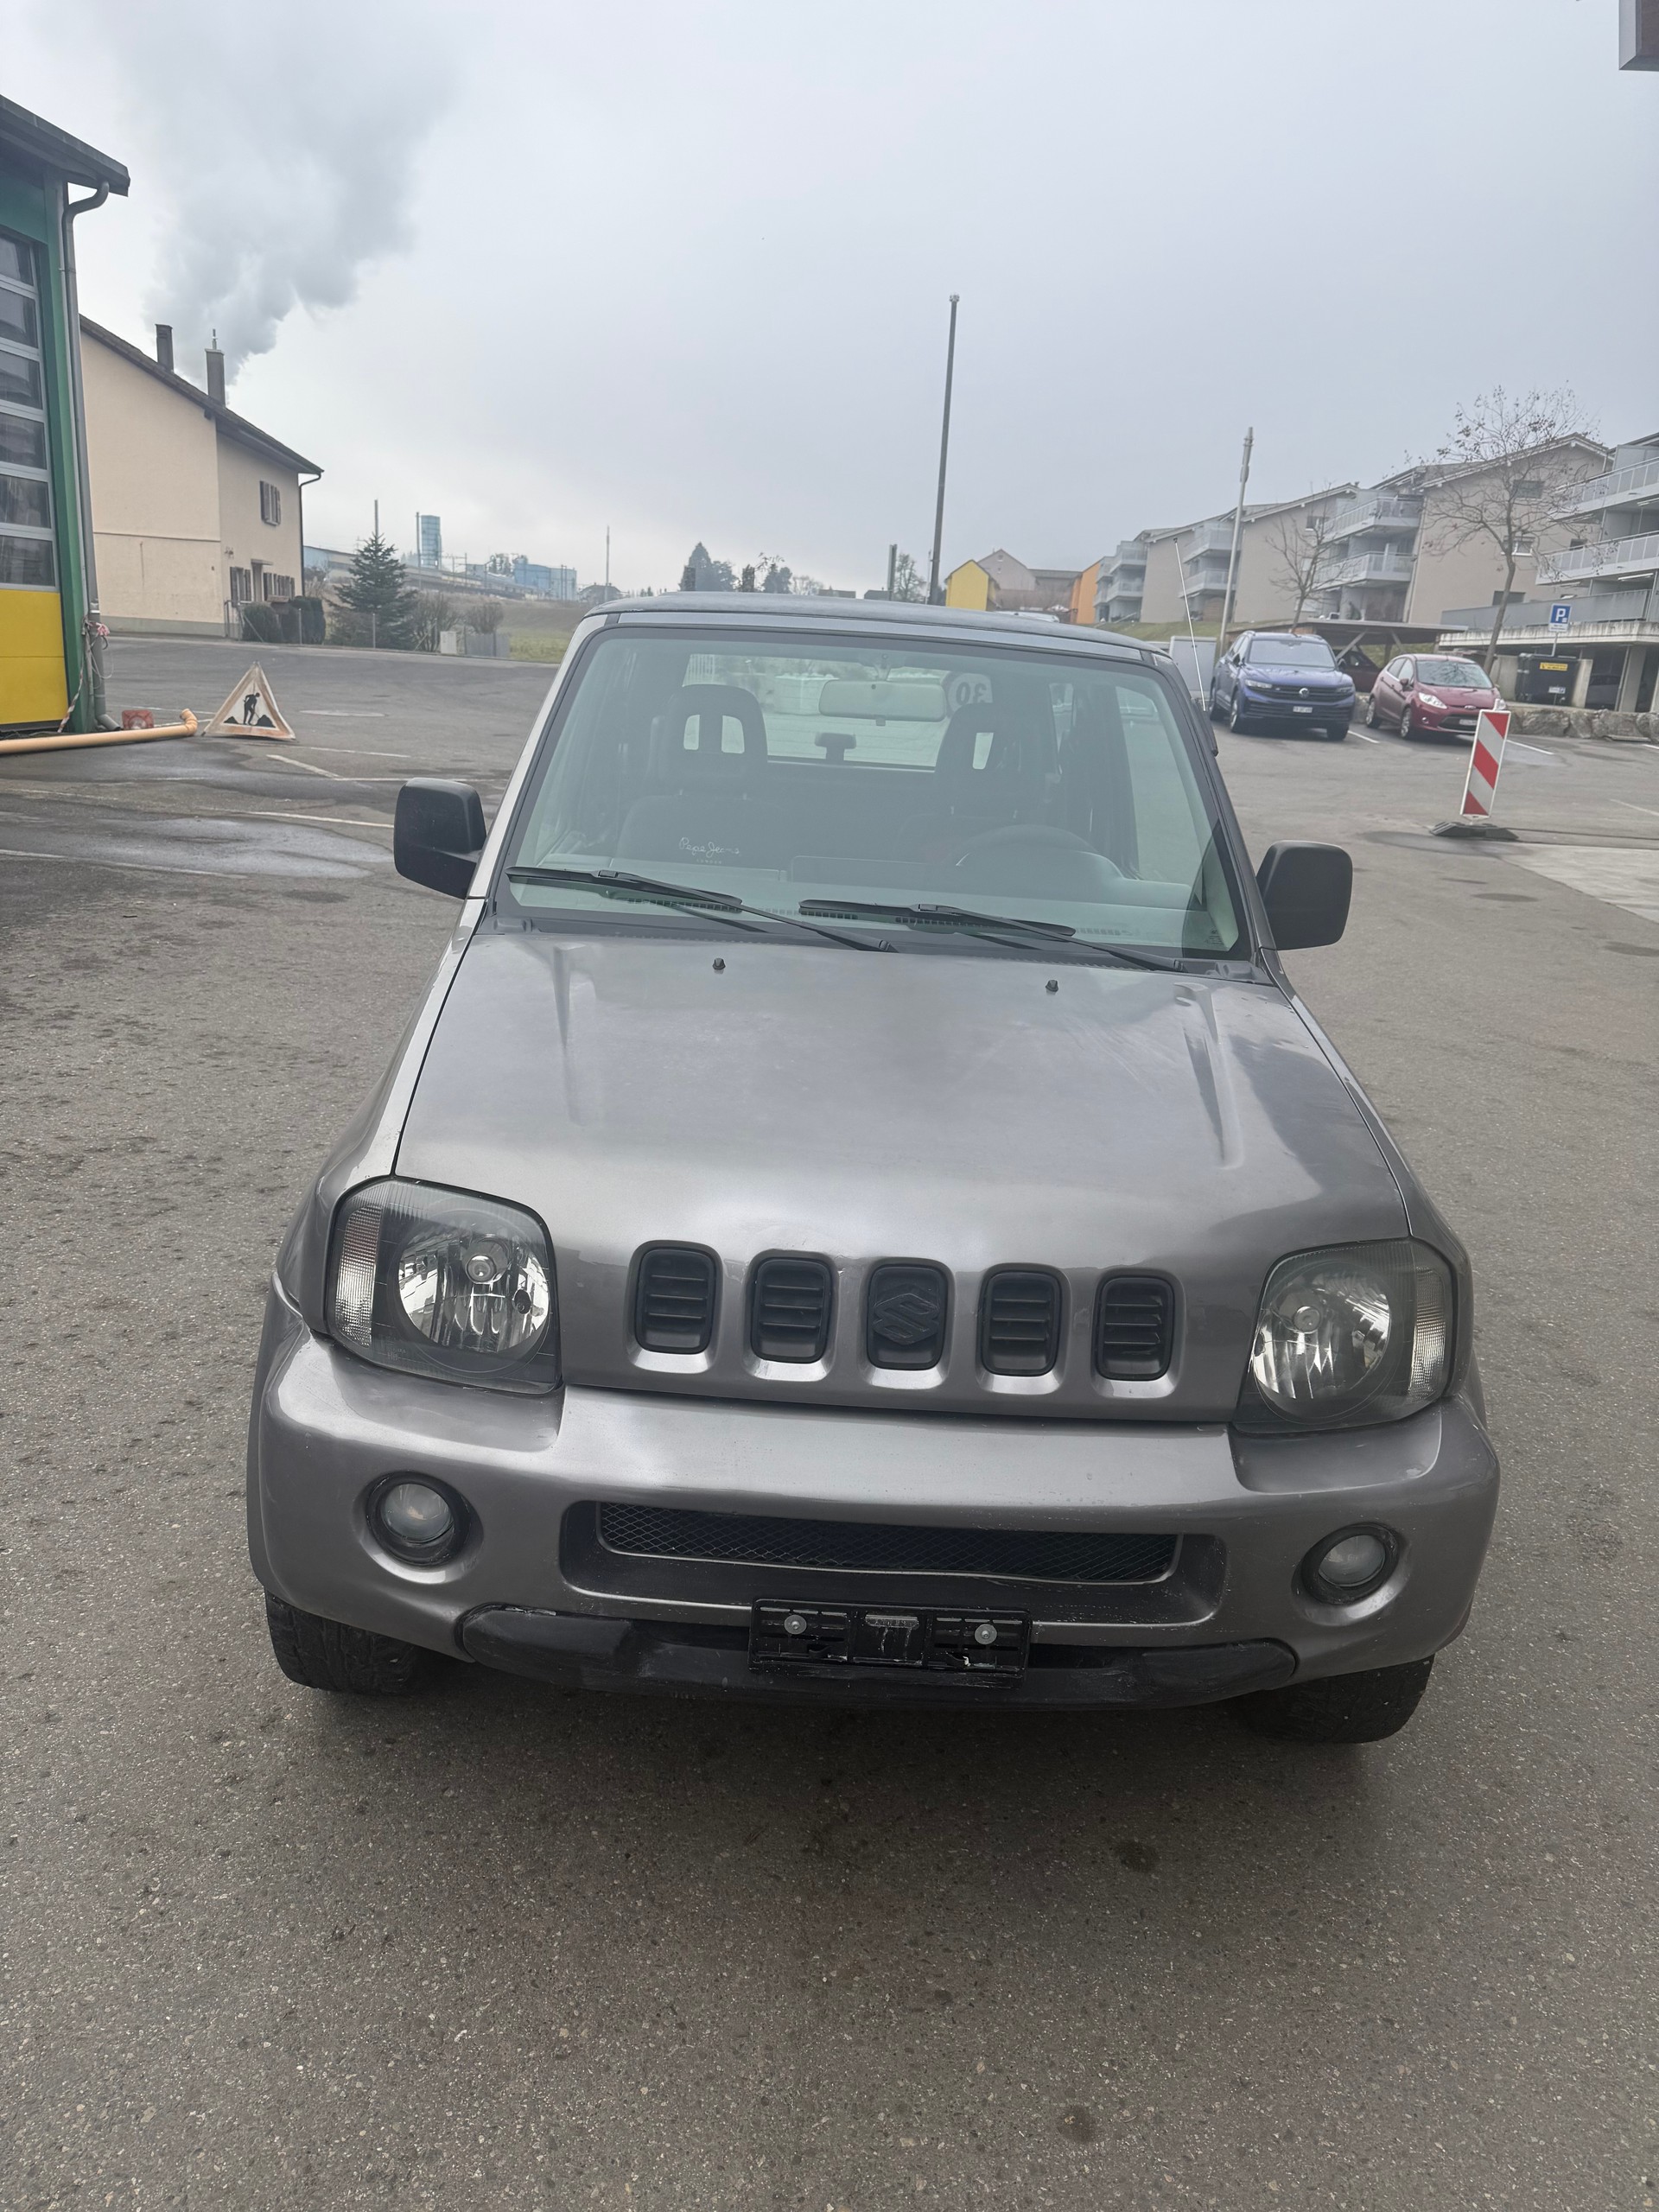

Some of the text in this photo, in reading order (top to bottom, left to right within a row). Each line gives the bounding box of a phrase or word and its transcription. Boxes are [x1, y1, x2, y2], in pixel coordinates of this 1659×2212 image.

[1555, 608, 1566, 621] P
[679, 836, 741, 858] Pepe Jeans
